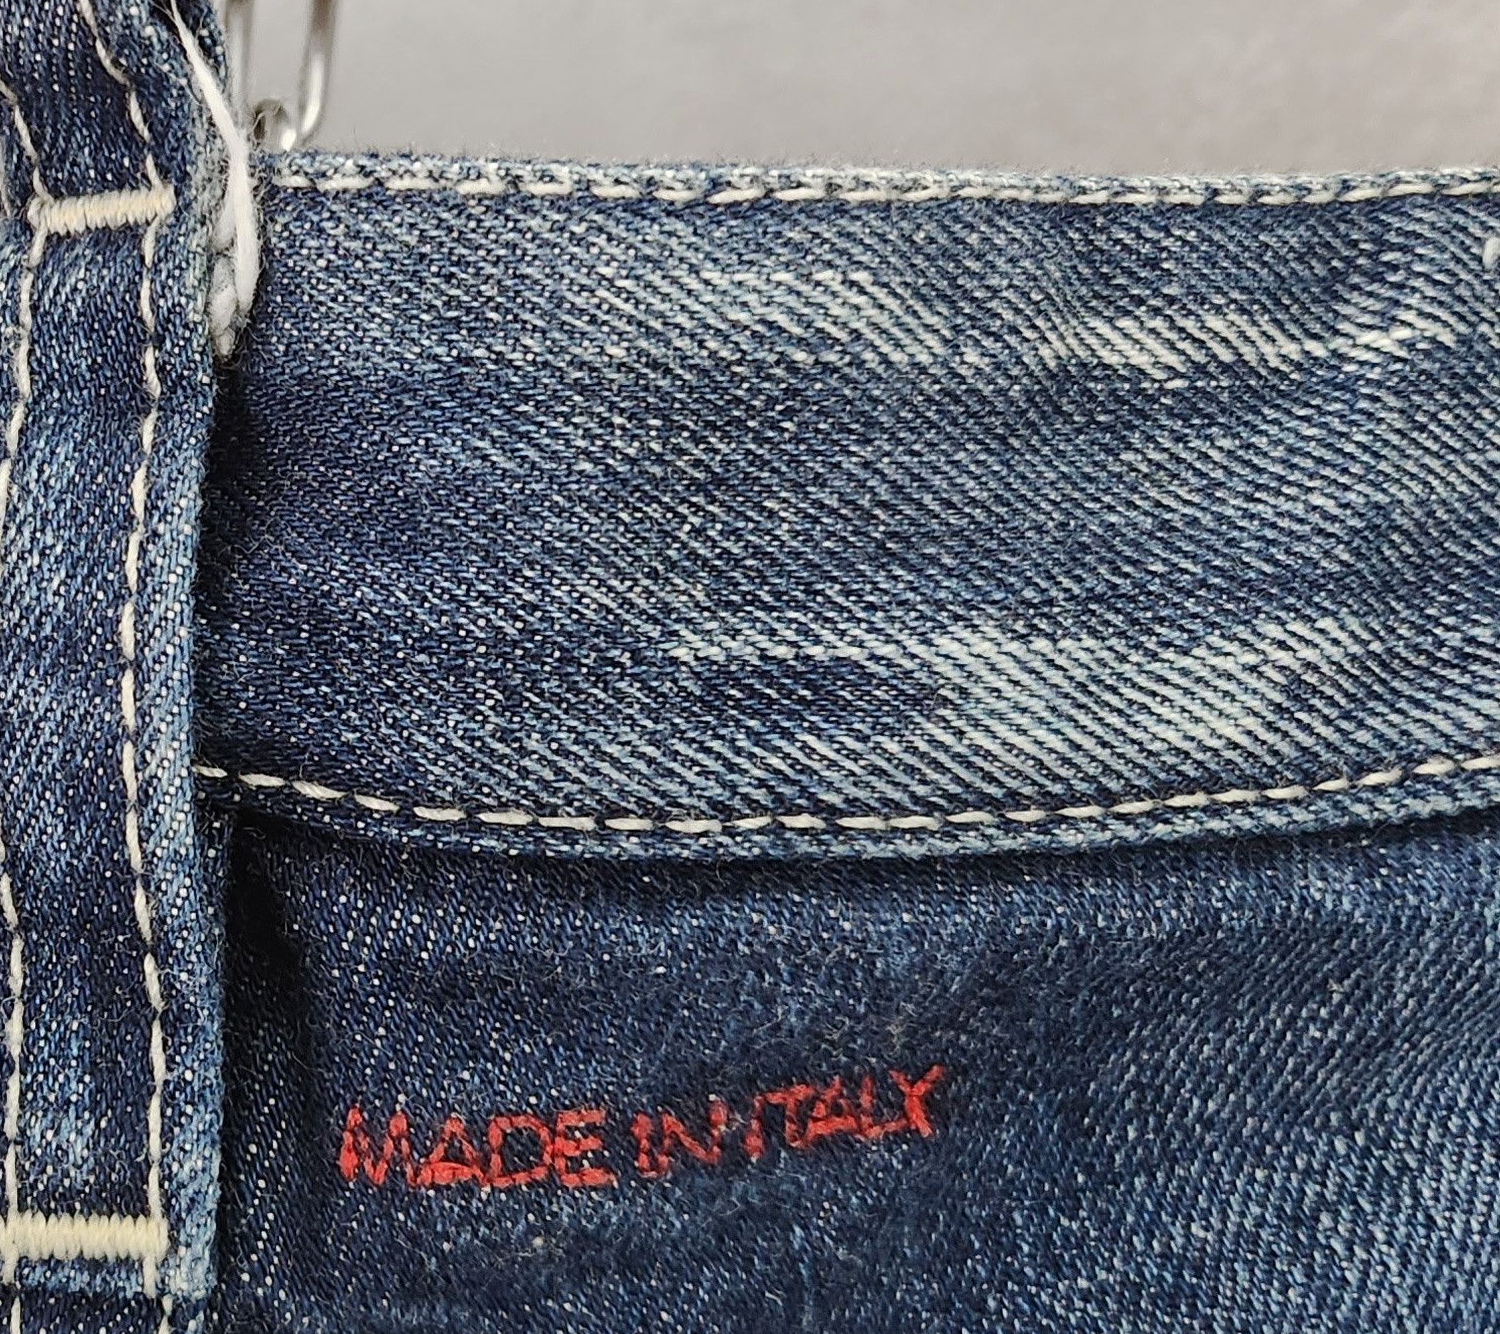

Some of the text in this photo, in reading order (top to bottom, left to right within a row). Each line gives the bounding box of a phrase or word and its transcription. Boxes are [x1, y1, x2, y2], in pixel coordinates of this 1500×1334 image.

[338, 1065, 944, 1189] MADE IN ITALY
